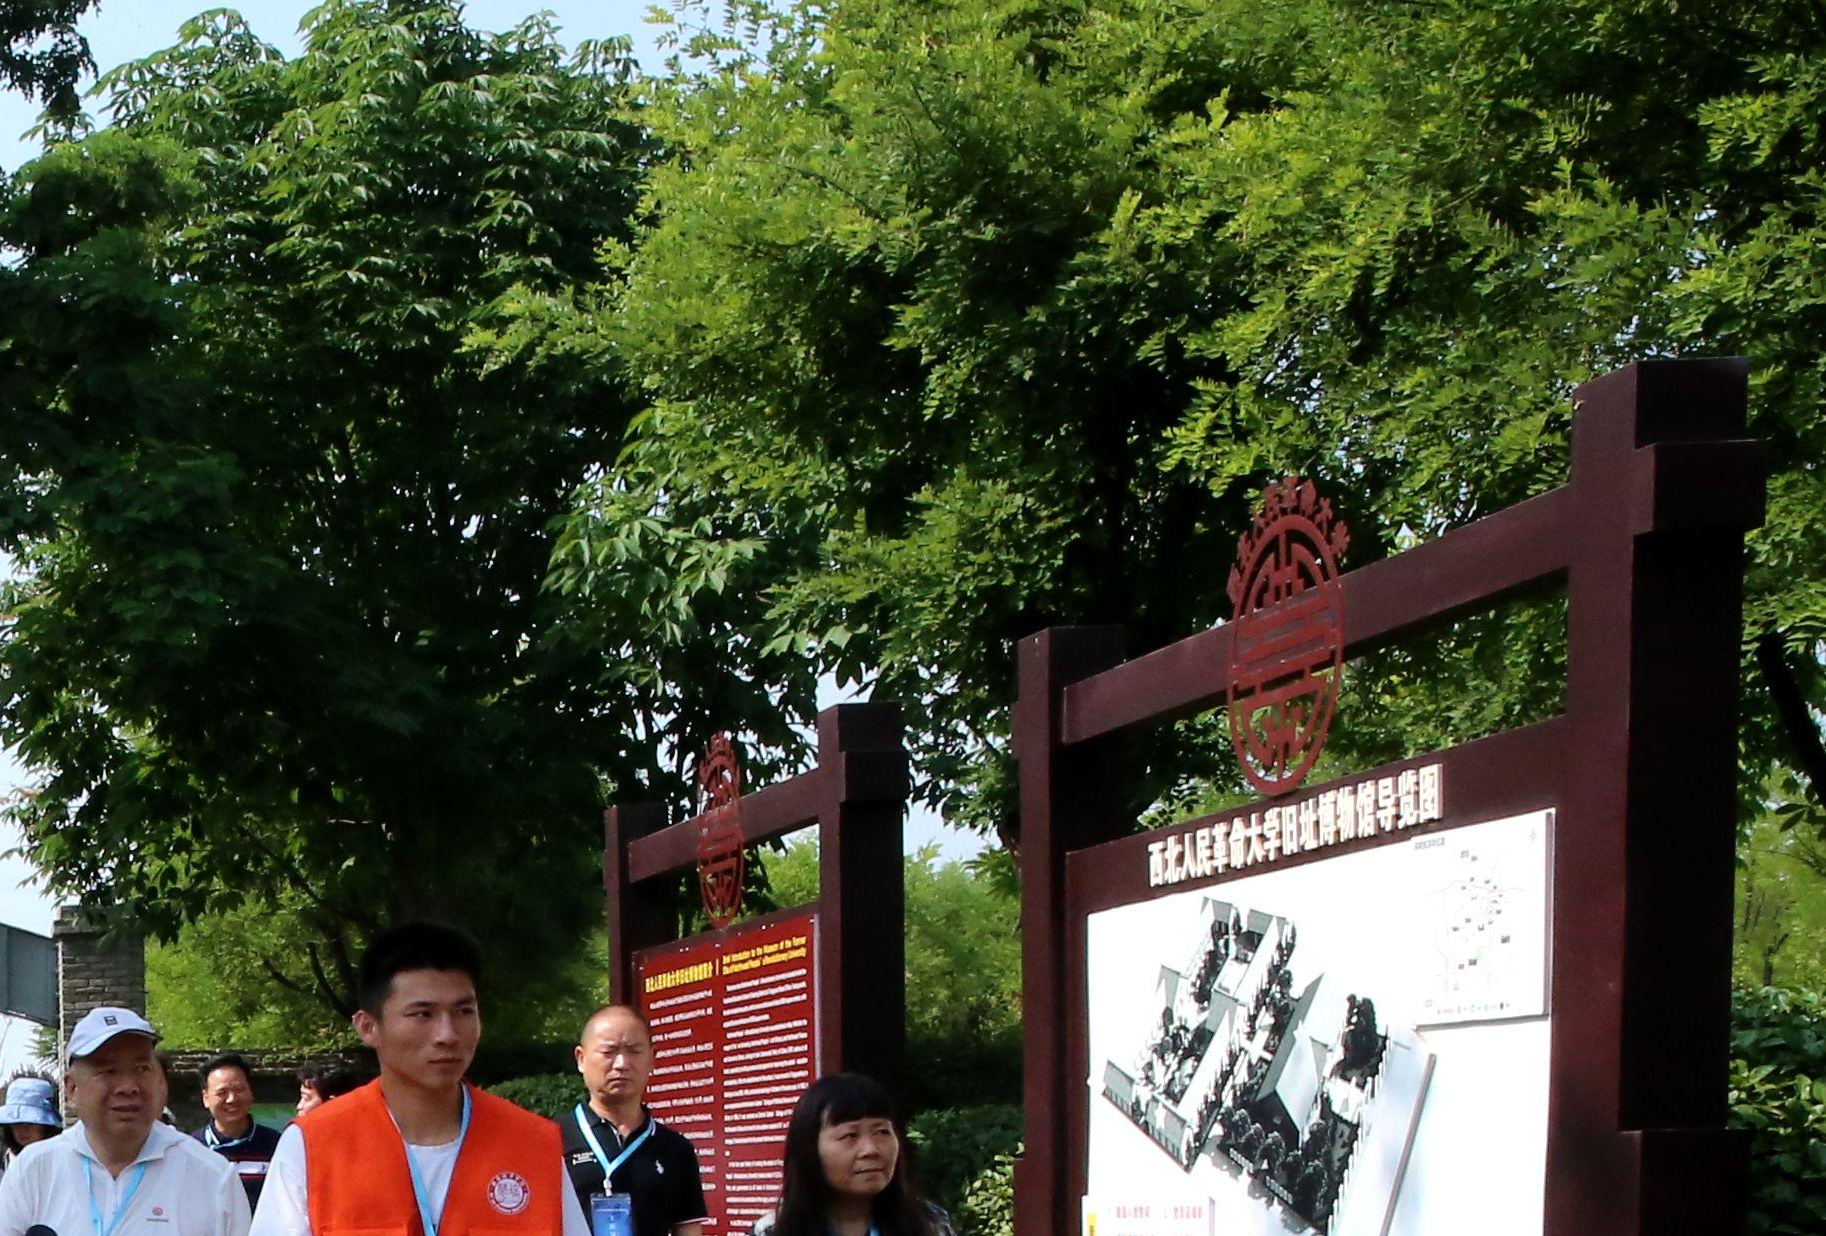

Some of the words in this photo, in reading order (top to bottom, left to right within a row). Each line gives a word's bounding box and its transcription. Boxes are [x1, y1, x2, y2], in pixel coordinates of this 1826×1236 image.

[1148, 763, 1443, 887] 西北人民革命大学旧址博物馆导览图
